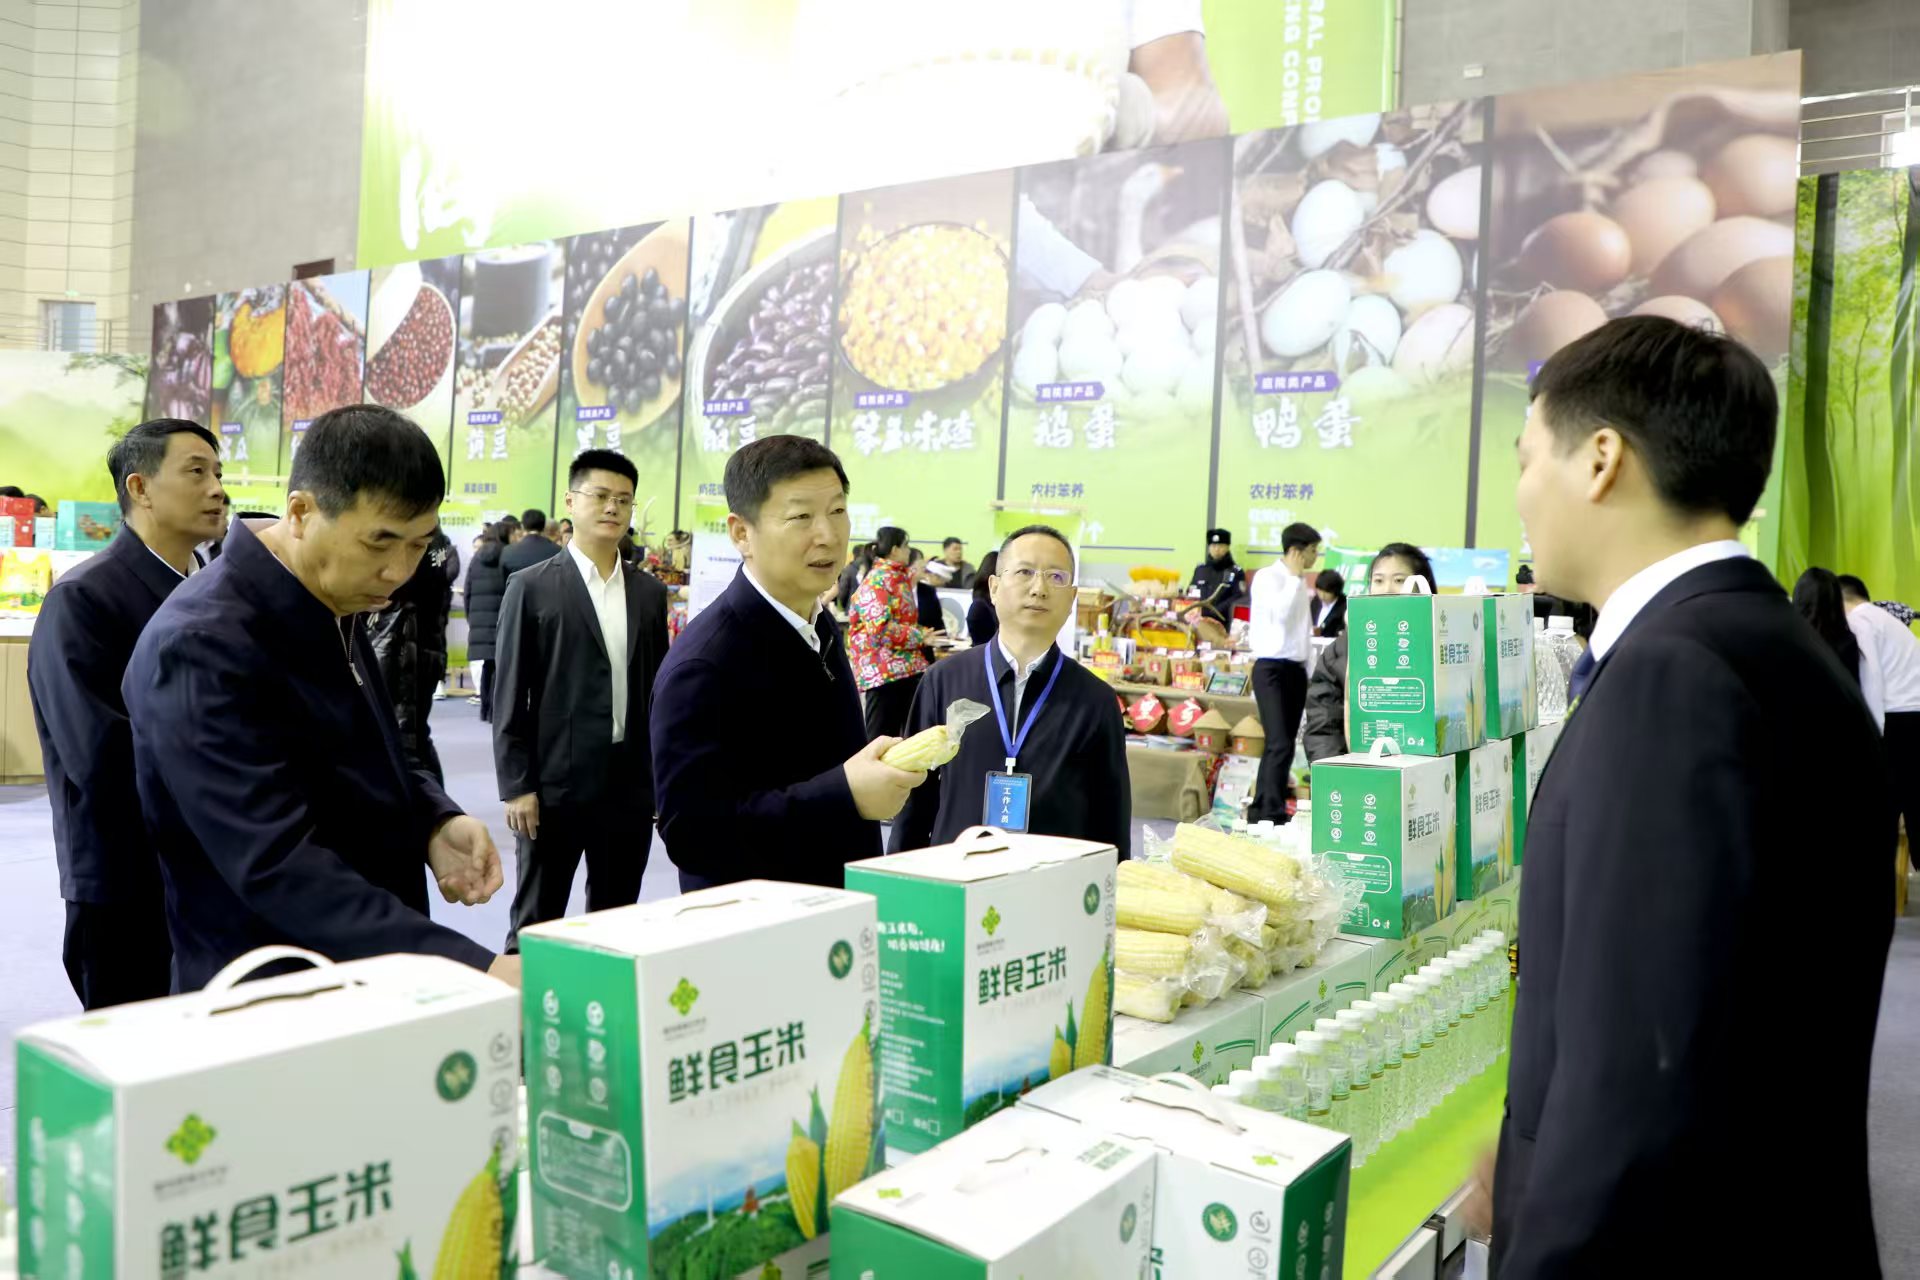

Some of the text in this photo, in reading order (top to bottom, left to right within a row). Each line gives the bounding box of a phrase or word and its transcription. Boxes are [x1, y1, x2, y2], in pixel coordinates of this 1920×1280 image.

[1283, 0, 1302, 43] NG
[1034, 403, 1124, 448] 鹅蛋
[1252, 396, 1361, 448] 鸭蛋
[466, 427, 508, 459] 黄豆
[1031, 483, 1084, 498] 农村笨养
[1250, 483, 1314, 500] 农村笨养
[1440, 643, 1470, 665] 鲜食玉米
[1000, 787, 1011, 824] 工作人员
[1475, 788, 1501, 814] 鲜食玉米
[1408, 810, 1440, 841] 鲜食玉米
[979, 946, 1067, 1005] 鲜食玉米
[668, 1020, 807, 1105] 鲜食玉米
[160, 1160, 393, 1280] 鲜食玉米
